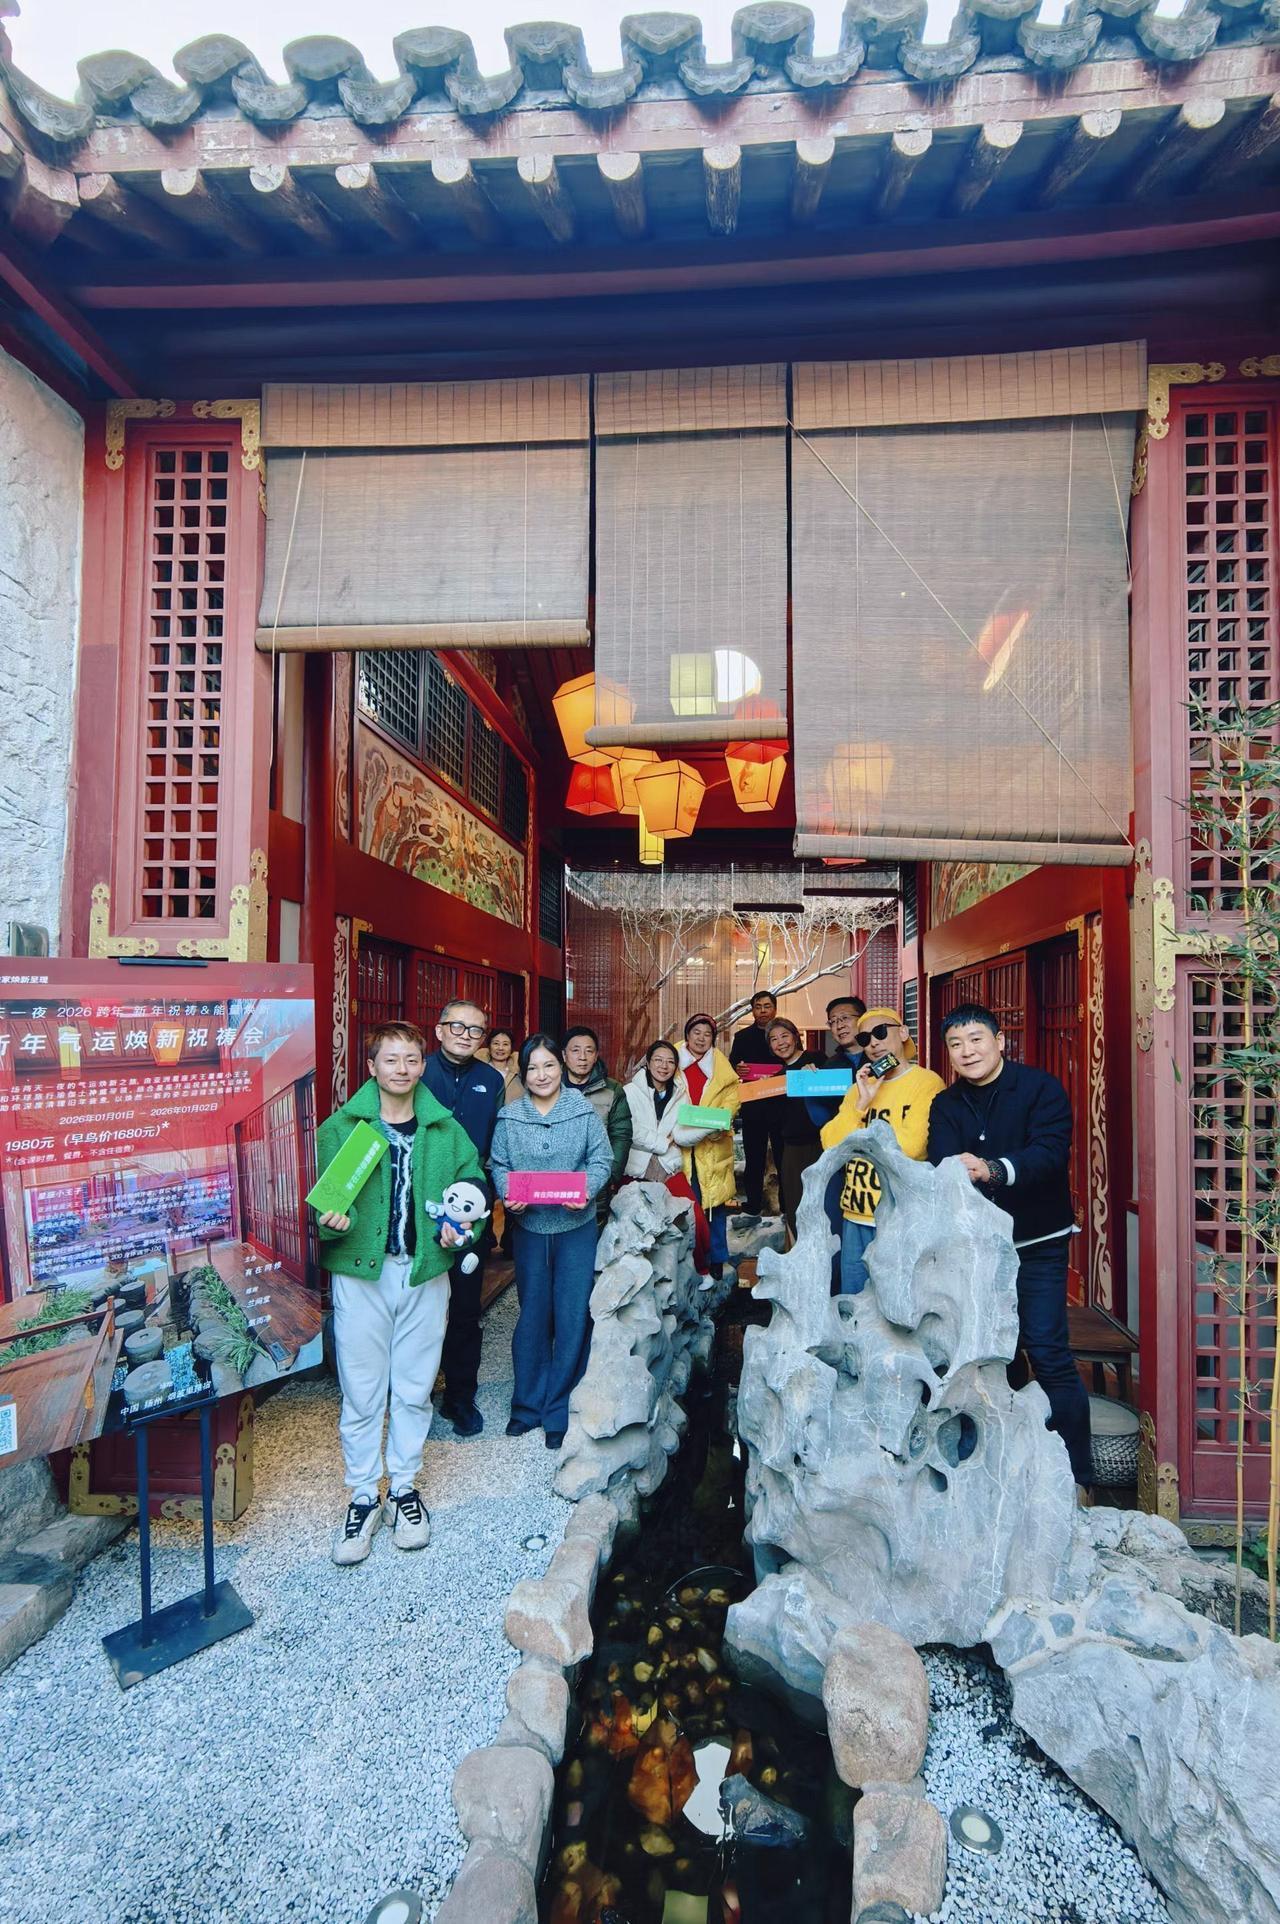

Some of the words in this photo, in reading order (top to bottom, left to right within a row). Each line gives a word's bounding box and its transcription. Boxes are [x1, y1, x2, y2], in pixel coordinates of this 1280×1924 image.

[0, 975, 48, 984] 家焕新呈现
[57, 1007, 92, 1017] 2026
[96, 1006, 123, 1017] 跨年
[59, 1111, 134, 1124] 2026年01月01日
[150, 1103, 218, 1117] 2026年01月02日
[5, 1136, 54, 1151] 1980元
